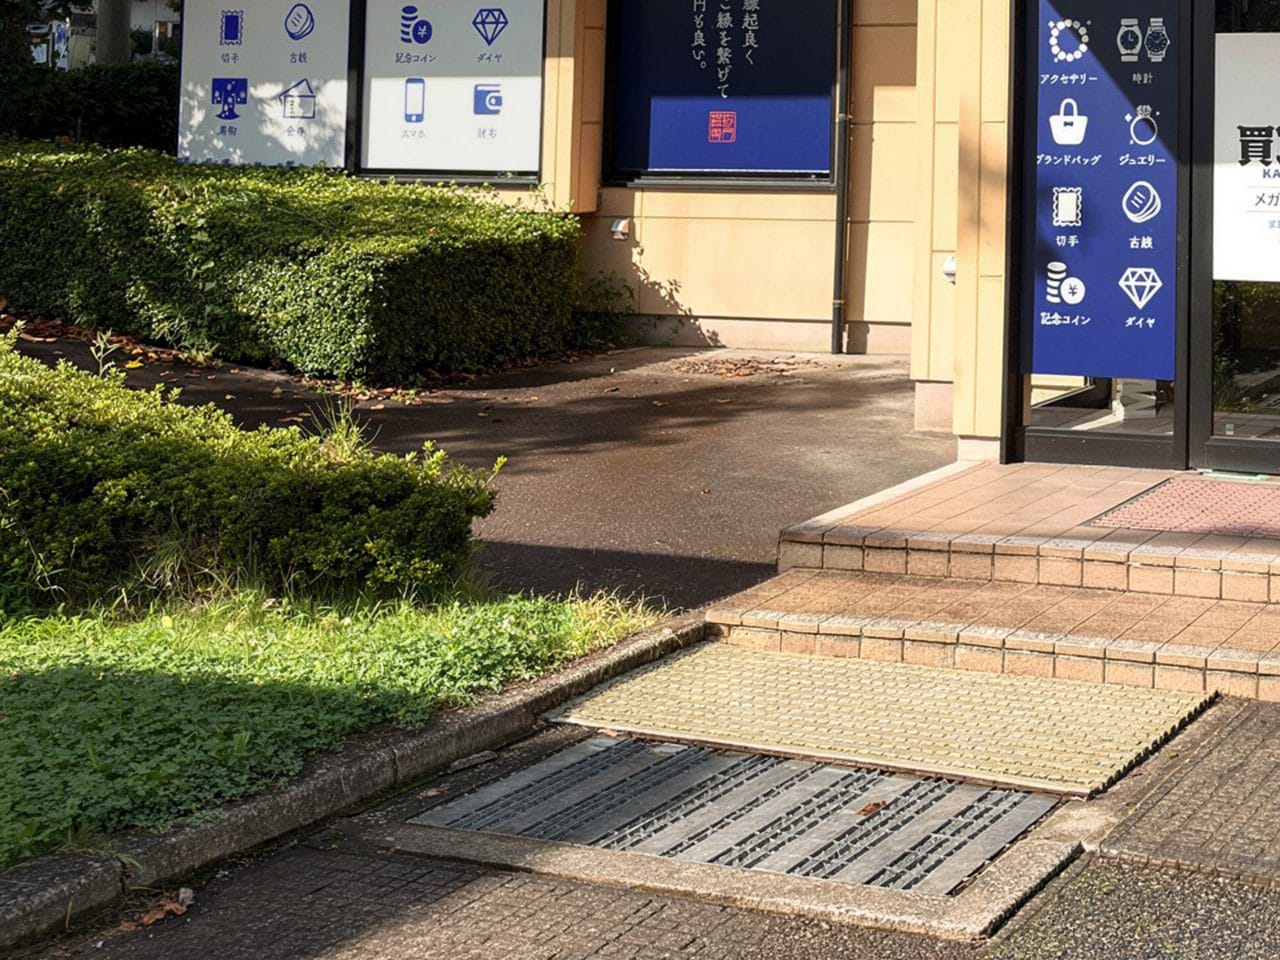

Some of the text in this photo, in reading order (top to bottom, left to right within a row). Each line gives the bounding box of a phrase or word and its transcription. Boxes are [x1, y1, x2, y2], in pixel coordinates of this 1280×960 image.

[1040, 73, 1098, 85] アクセサリー
[1132, 72, 1154, 84] 時計
[1119, 153, 1166, 166] ジュエリー
[1056, 235, 1079, 247] 切手
[1040, 312, 1091, 326] 記念コイン
[1125, 316, 1156, 328] ダイヤ
